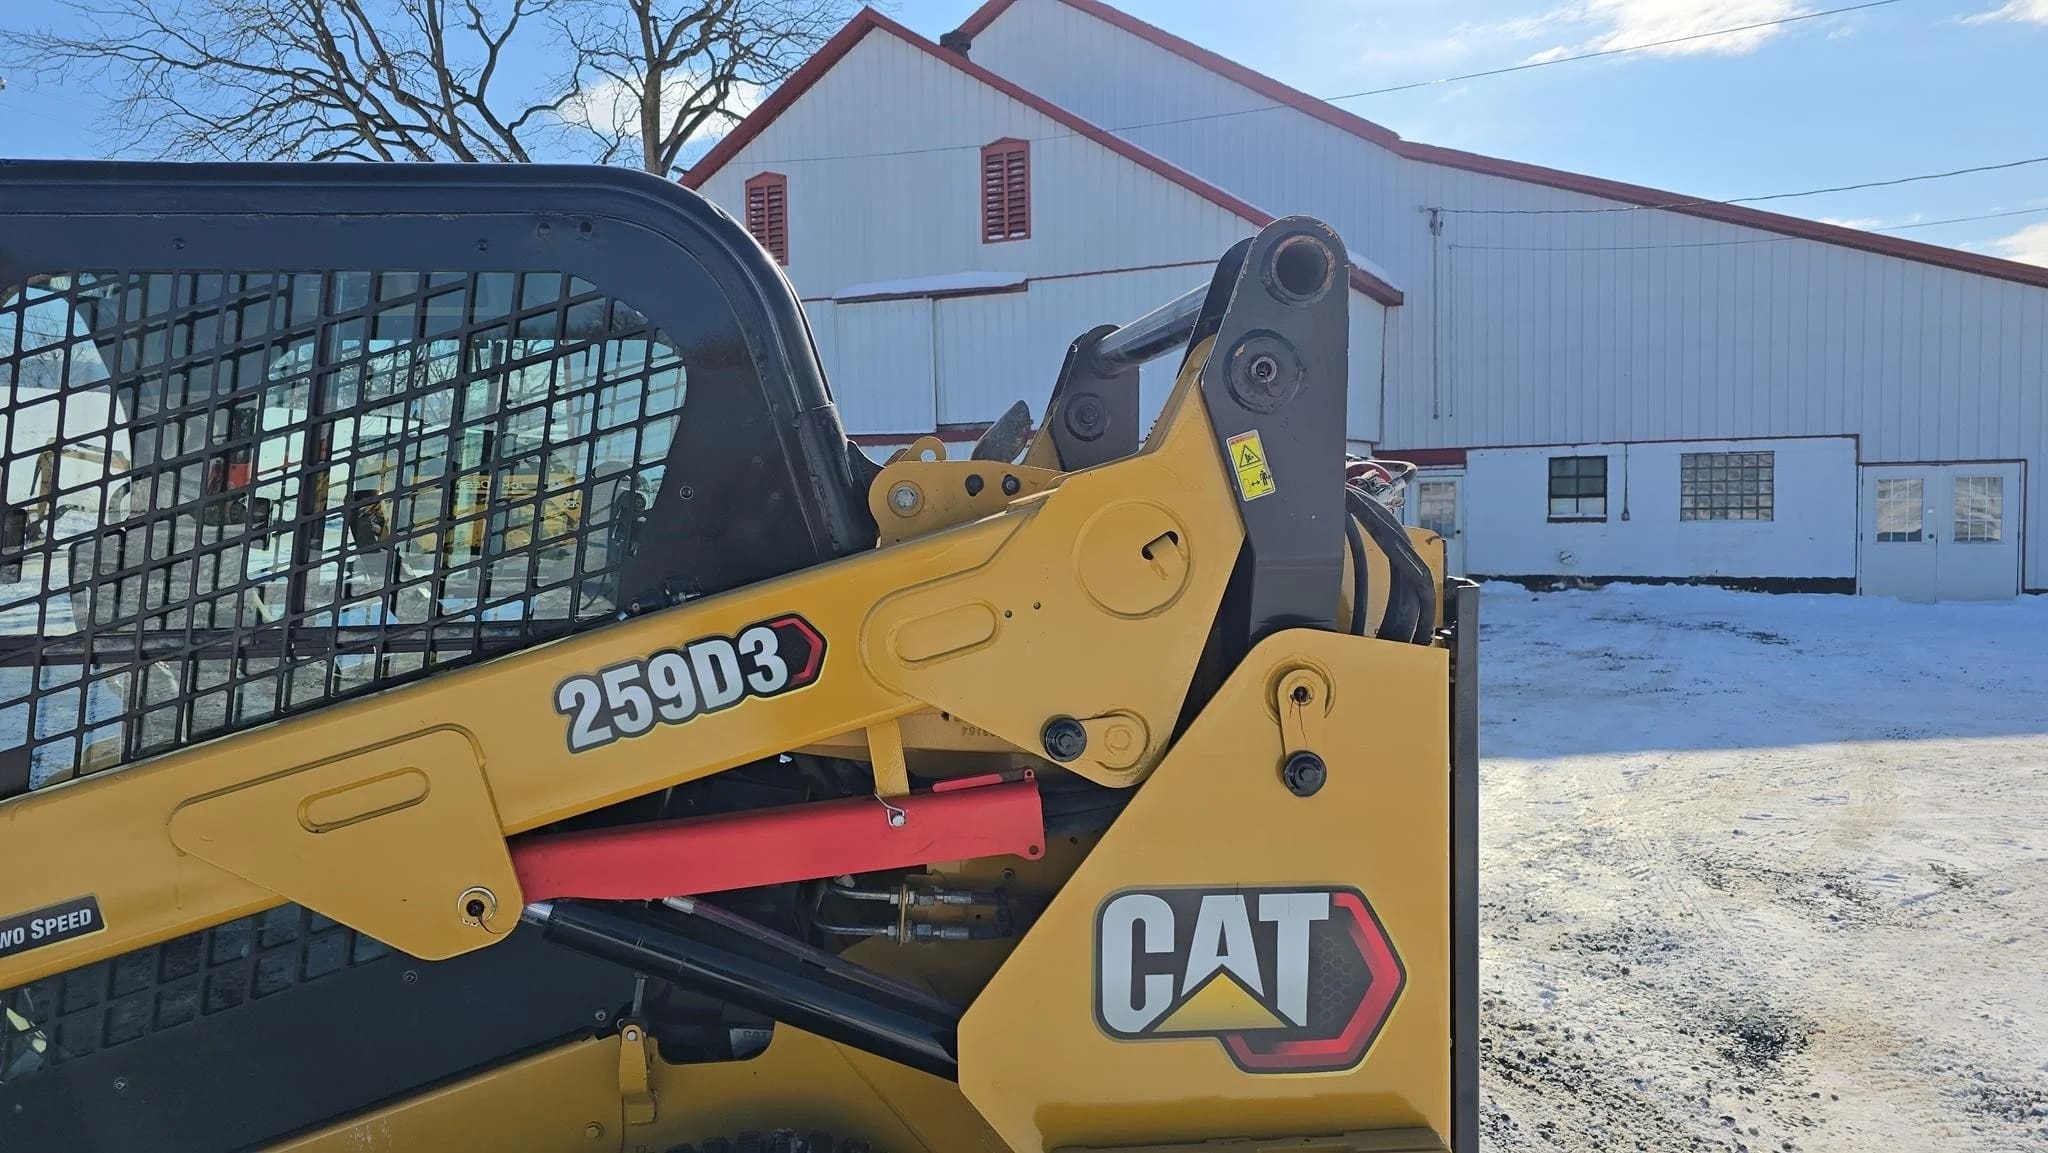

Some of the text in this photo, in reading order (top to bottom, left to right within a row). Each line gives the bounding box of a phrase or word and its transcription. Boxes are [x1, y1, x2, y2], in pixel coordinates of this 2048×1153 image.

[559, 626, 788, 749] 259D3
[30, 908, 92, 940] SPEED
[1102, 893, 1330, 1033] CAT
